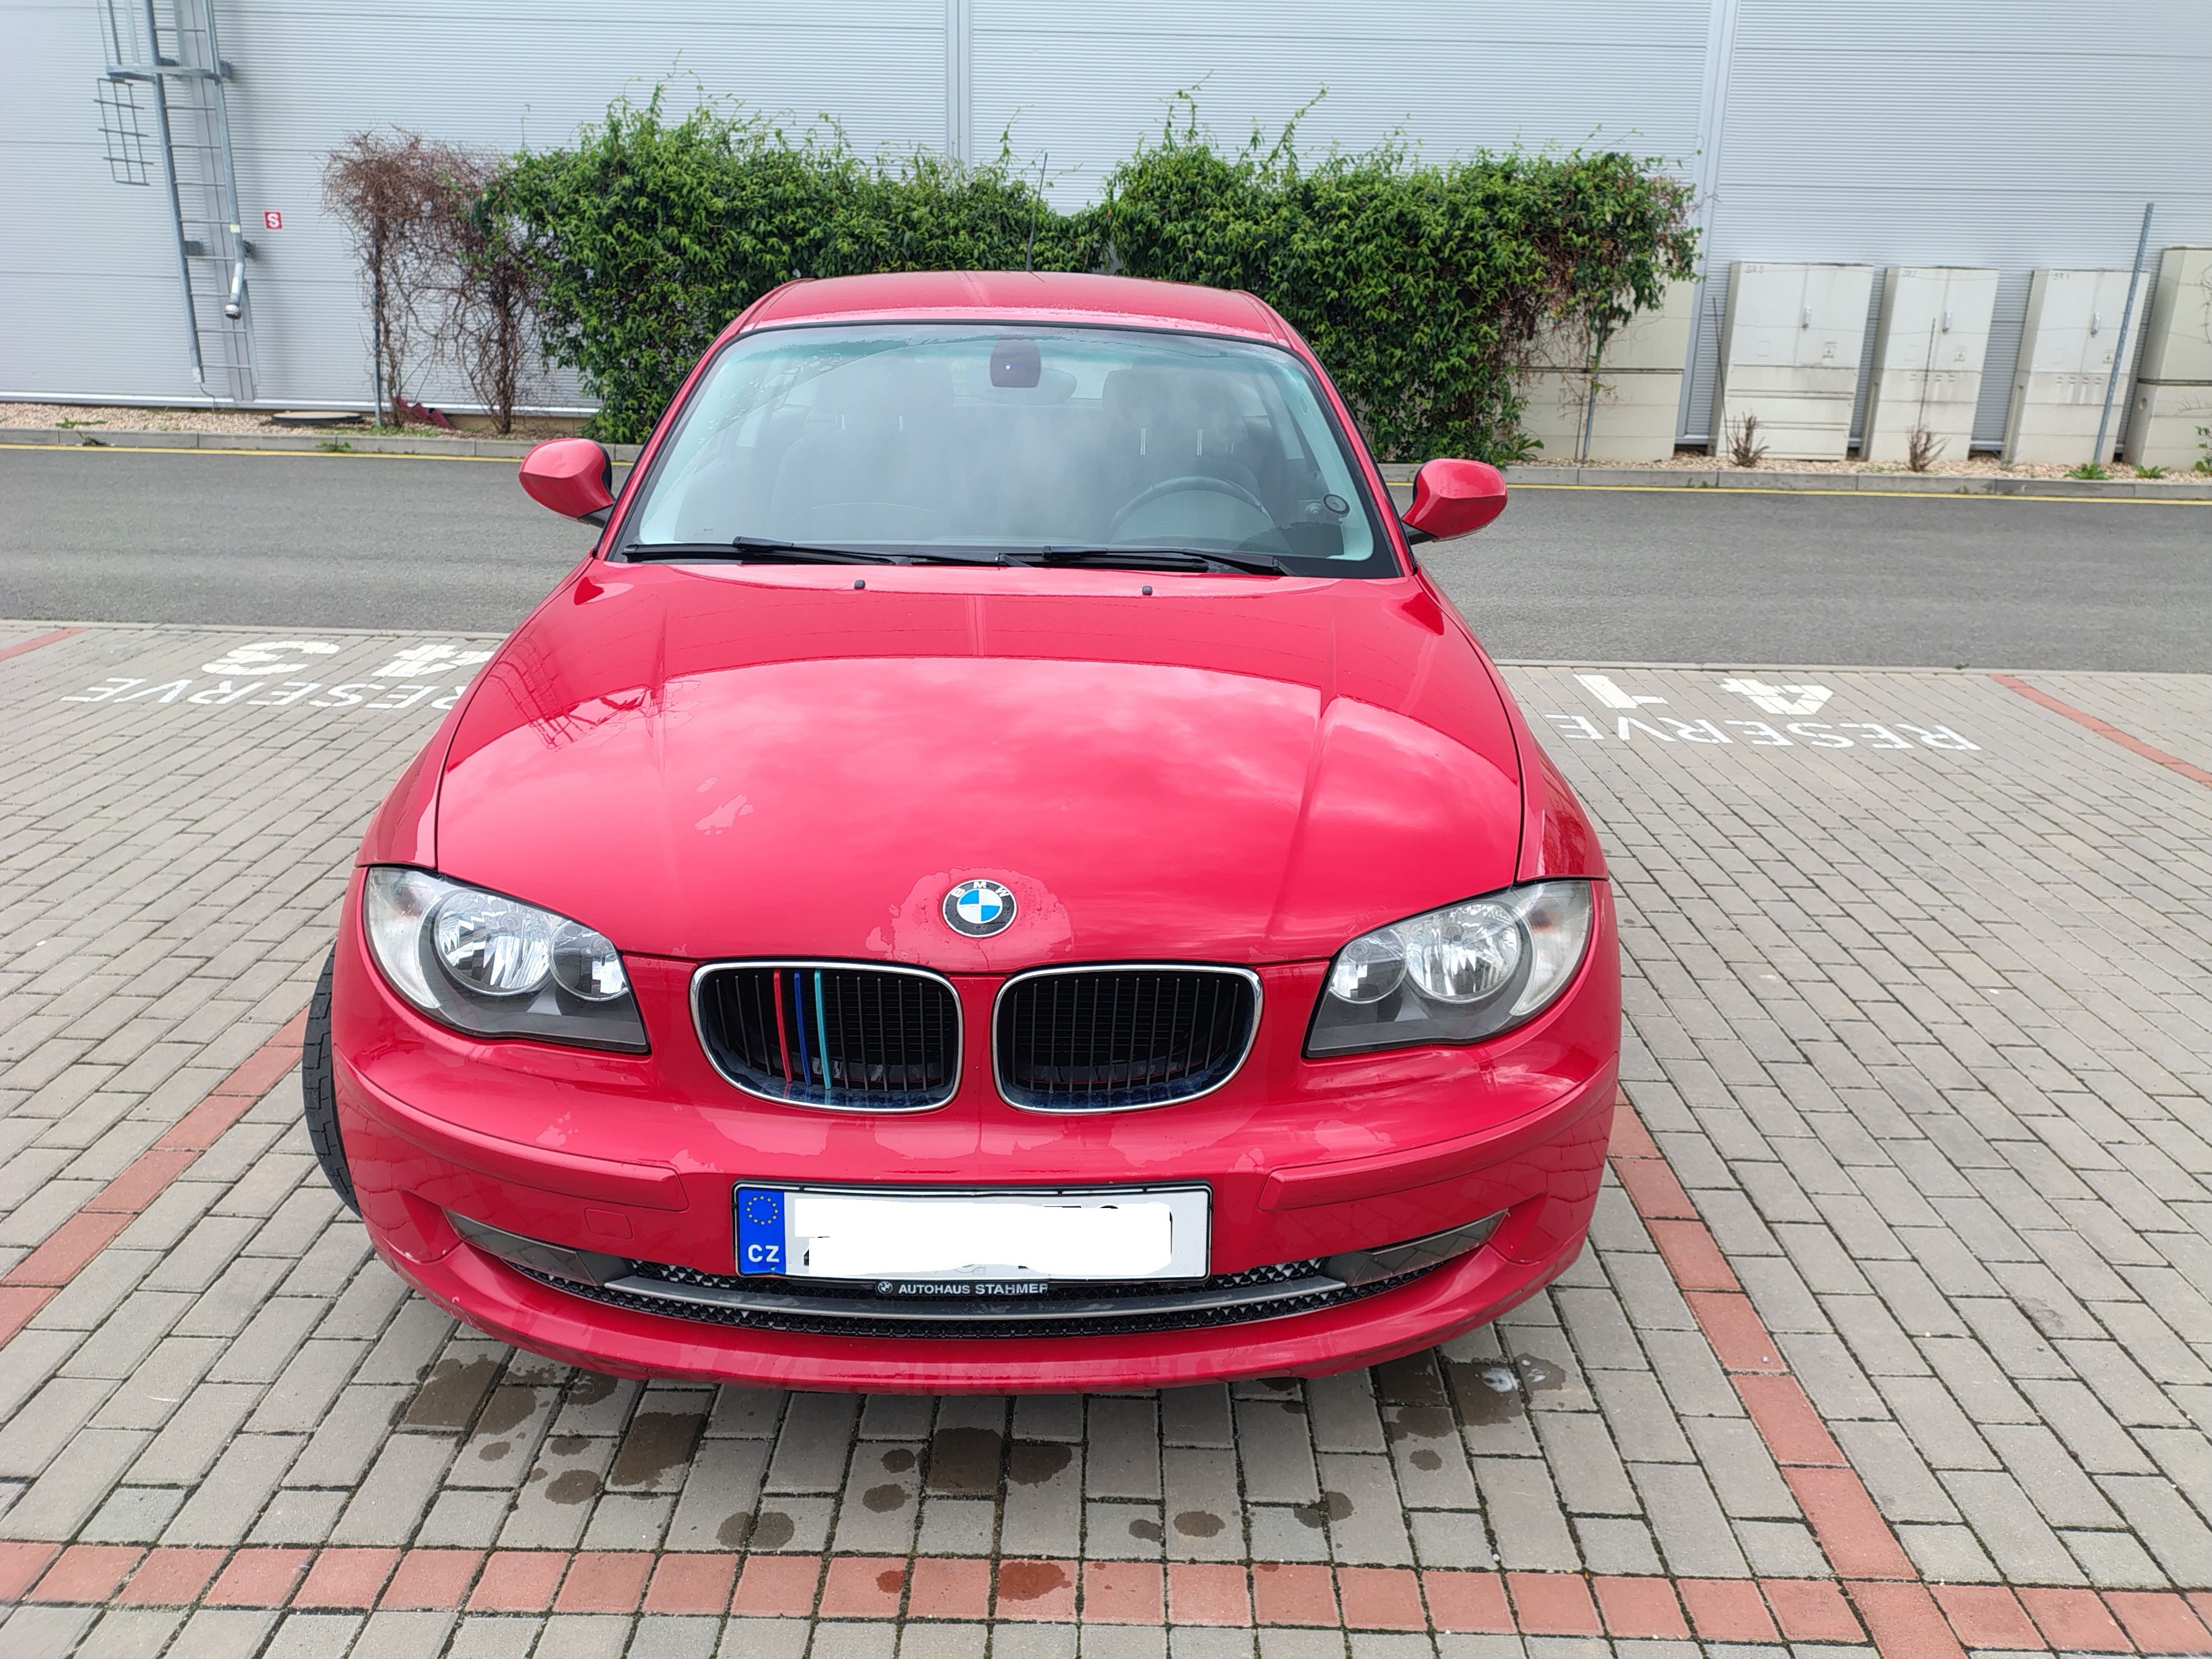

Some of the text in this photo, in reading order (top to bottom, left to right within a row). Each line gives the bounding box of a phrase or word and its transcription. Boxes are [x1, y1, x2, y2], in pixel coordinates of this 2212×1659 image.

[267, 213, 280, 228] S
[1545, 714, 1982, 751] RESERVE
[950, 881, 1010, 898] BMW
[747, 1244, 780, 1263] CZ
[899, 1284, 970, 1294] AUTOHAUS
